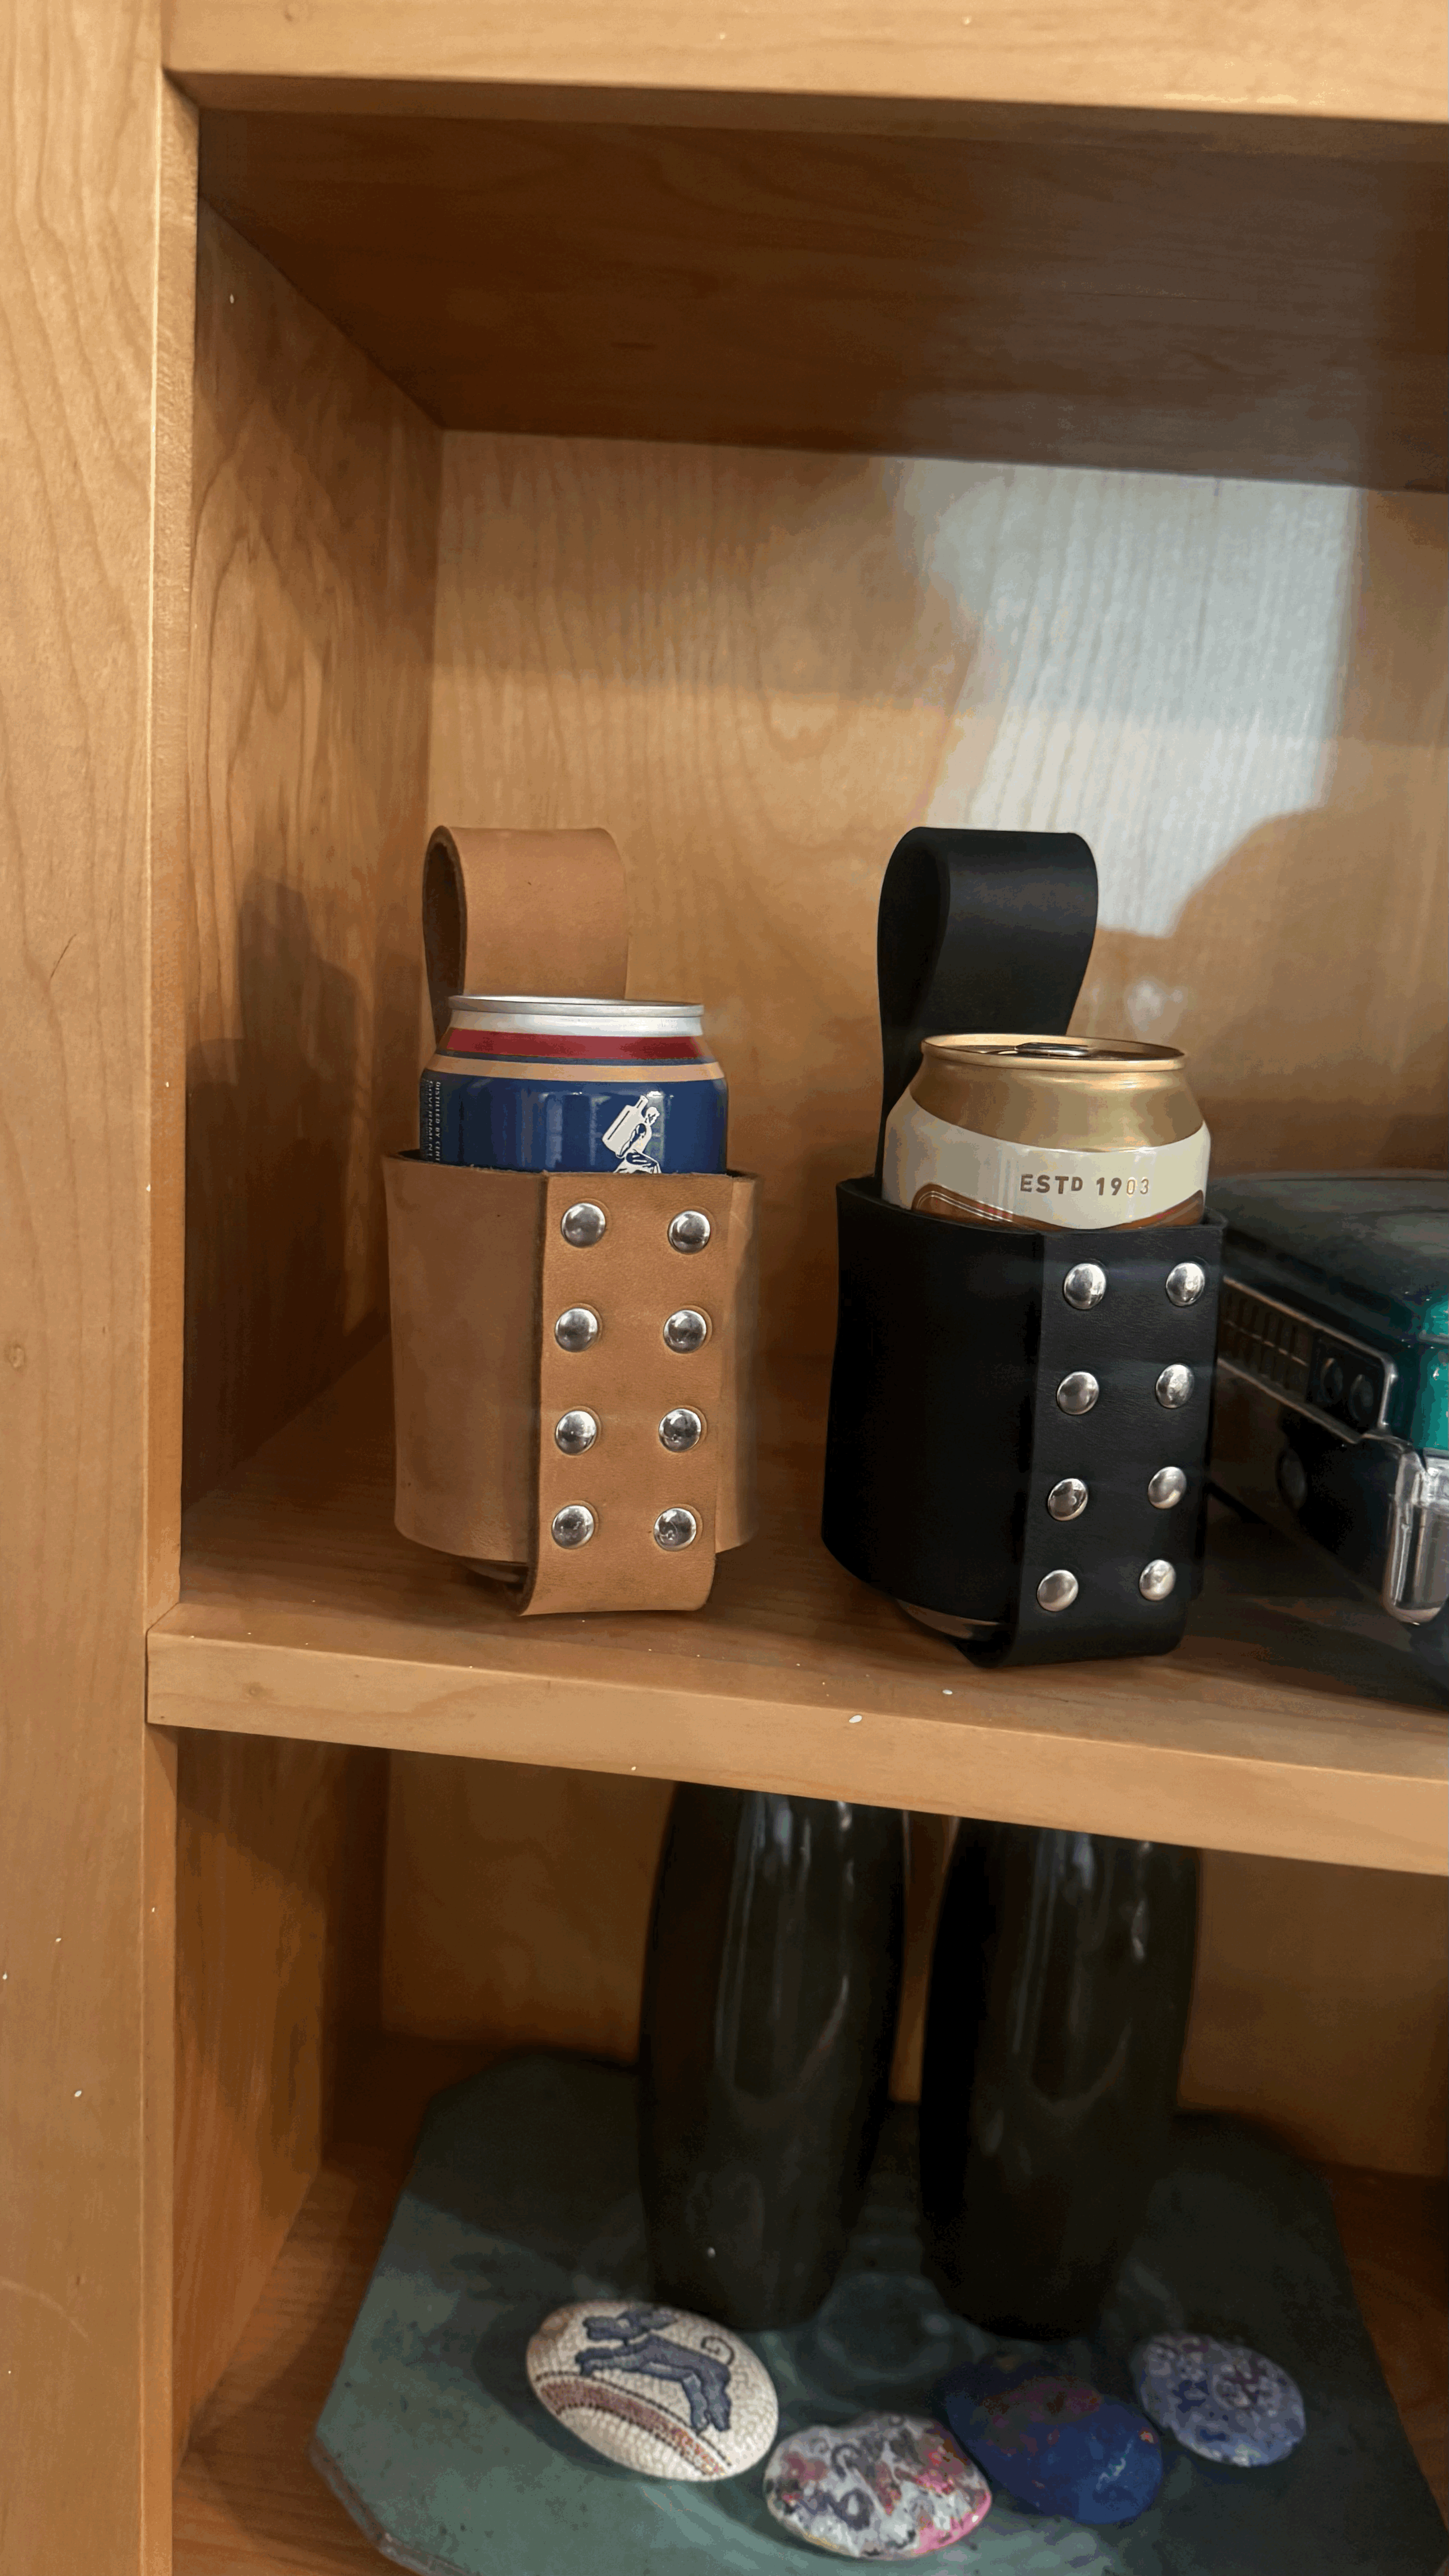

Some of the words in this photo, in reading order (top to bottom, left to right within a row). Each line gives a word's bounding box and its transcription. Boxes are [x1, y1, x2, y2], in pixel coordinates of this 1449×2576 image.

[435, 1127, 440, 1138] BY
[1020, 1174, 1083, 1195] ESTD
[1096, 1176, 1149, 1196] 1903
